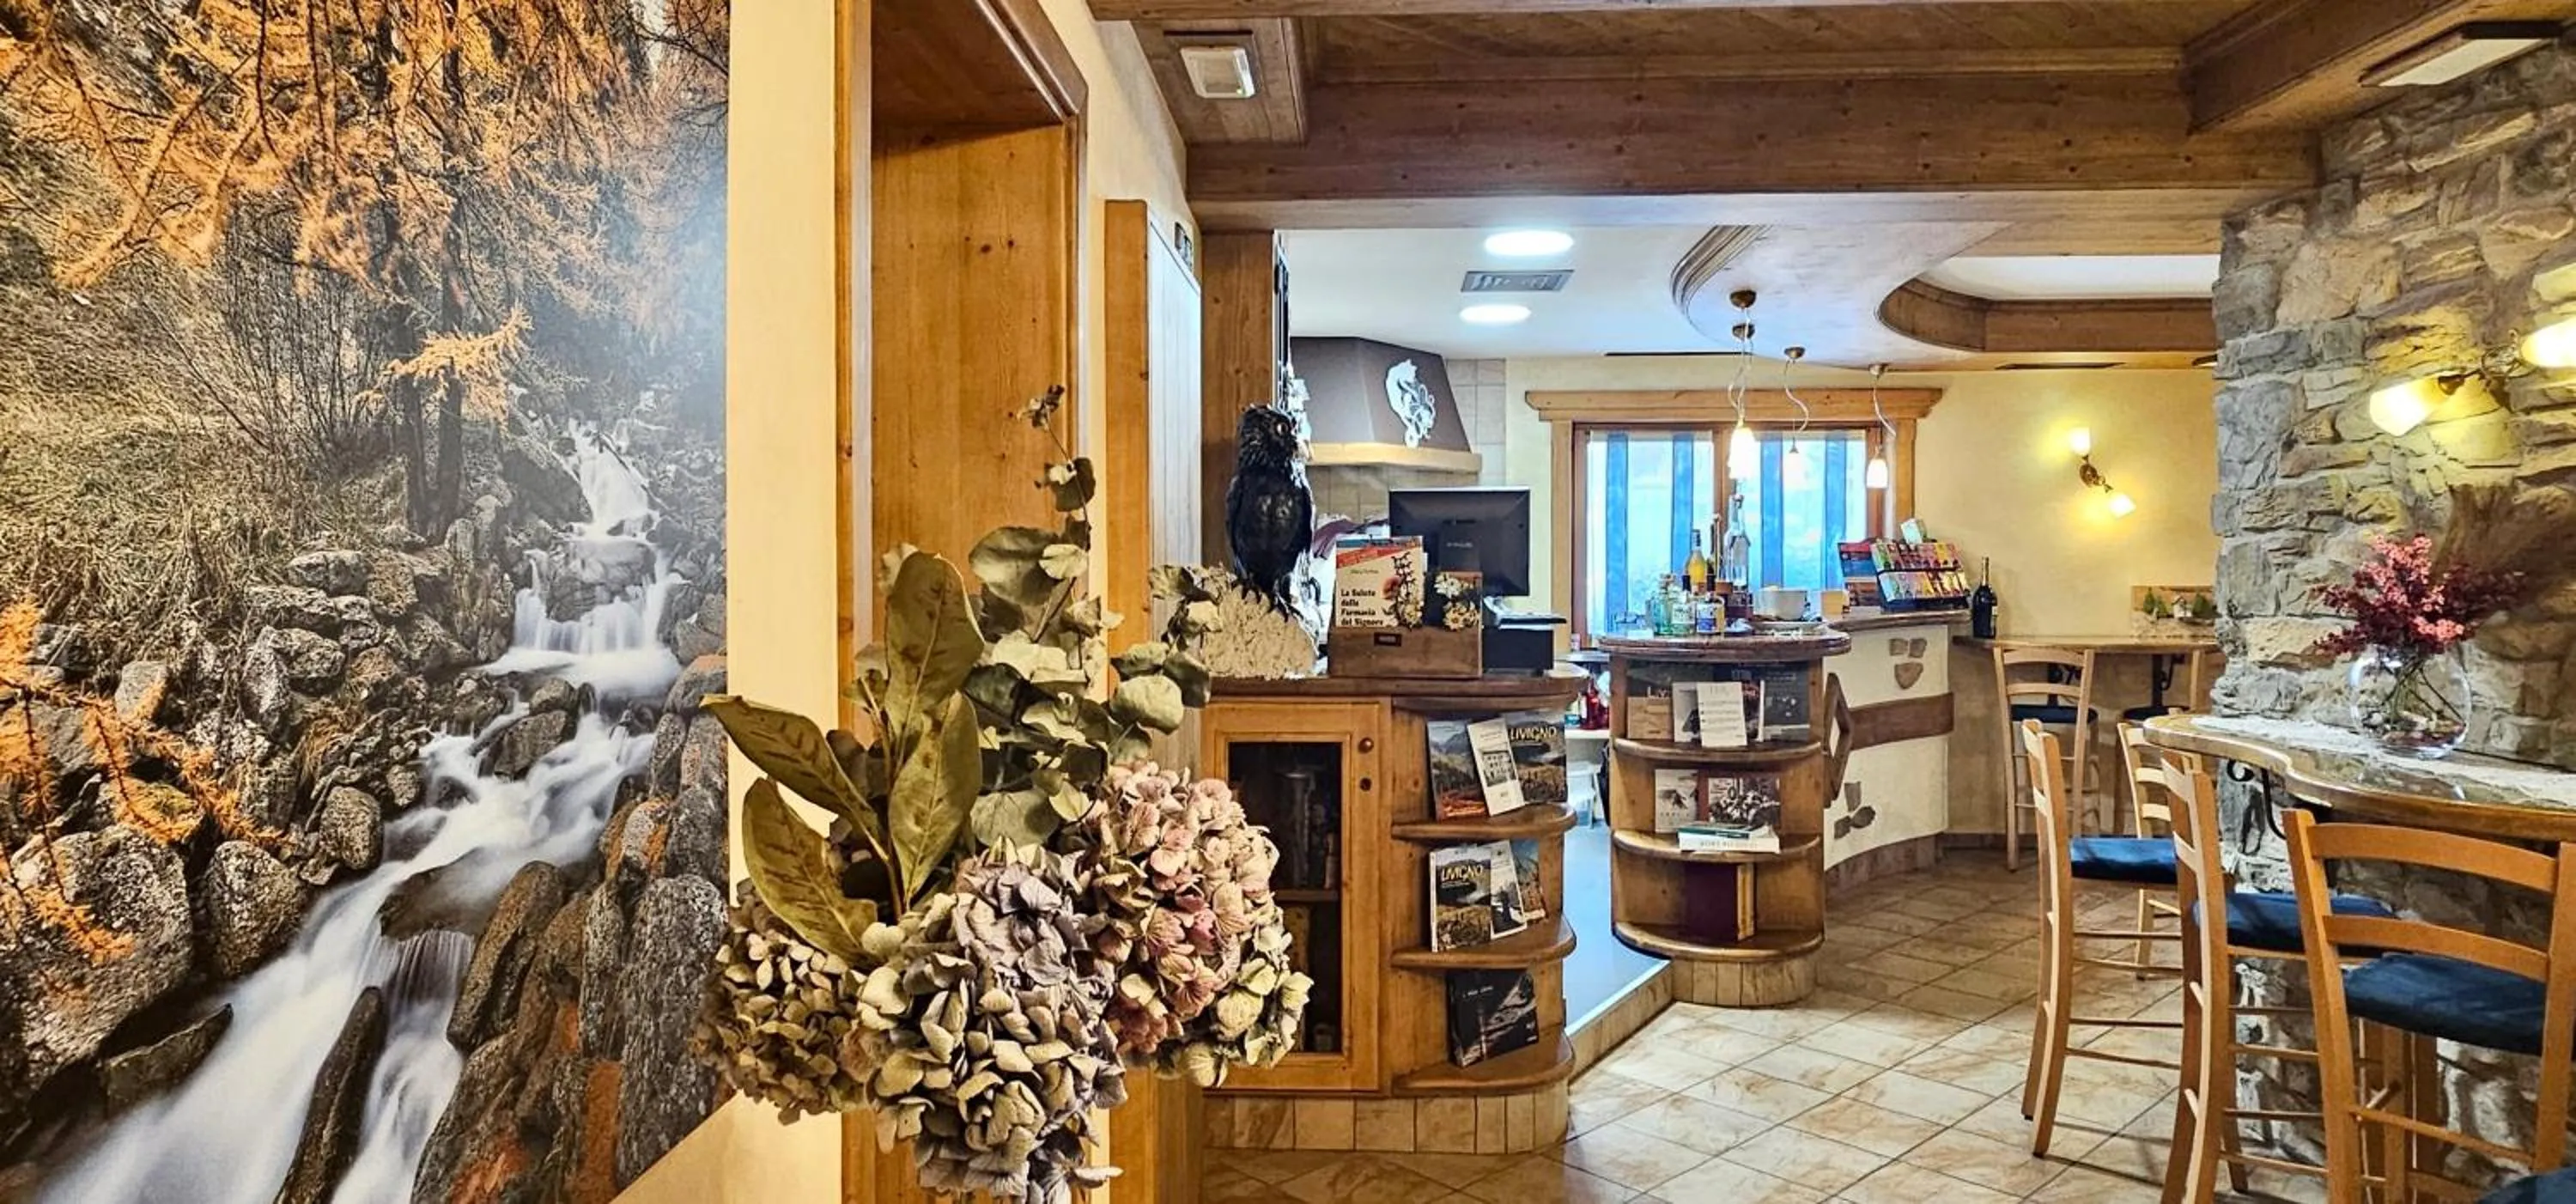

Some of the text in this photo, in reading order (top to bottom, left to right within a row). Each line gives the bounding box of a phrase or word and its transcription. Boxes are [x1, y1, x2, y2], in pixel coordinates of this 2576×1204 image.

[1340, 588, 1376, 597] La Salute
[1340, 617, 1384, 627] del Signore
[1510, 726, 1557, 741] LIVIGNO
[1441, 865, 1484, 882] LIVIGNO
